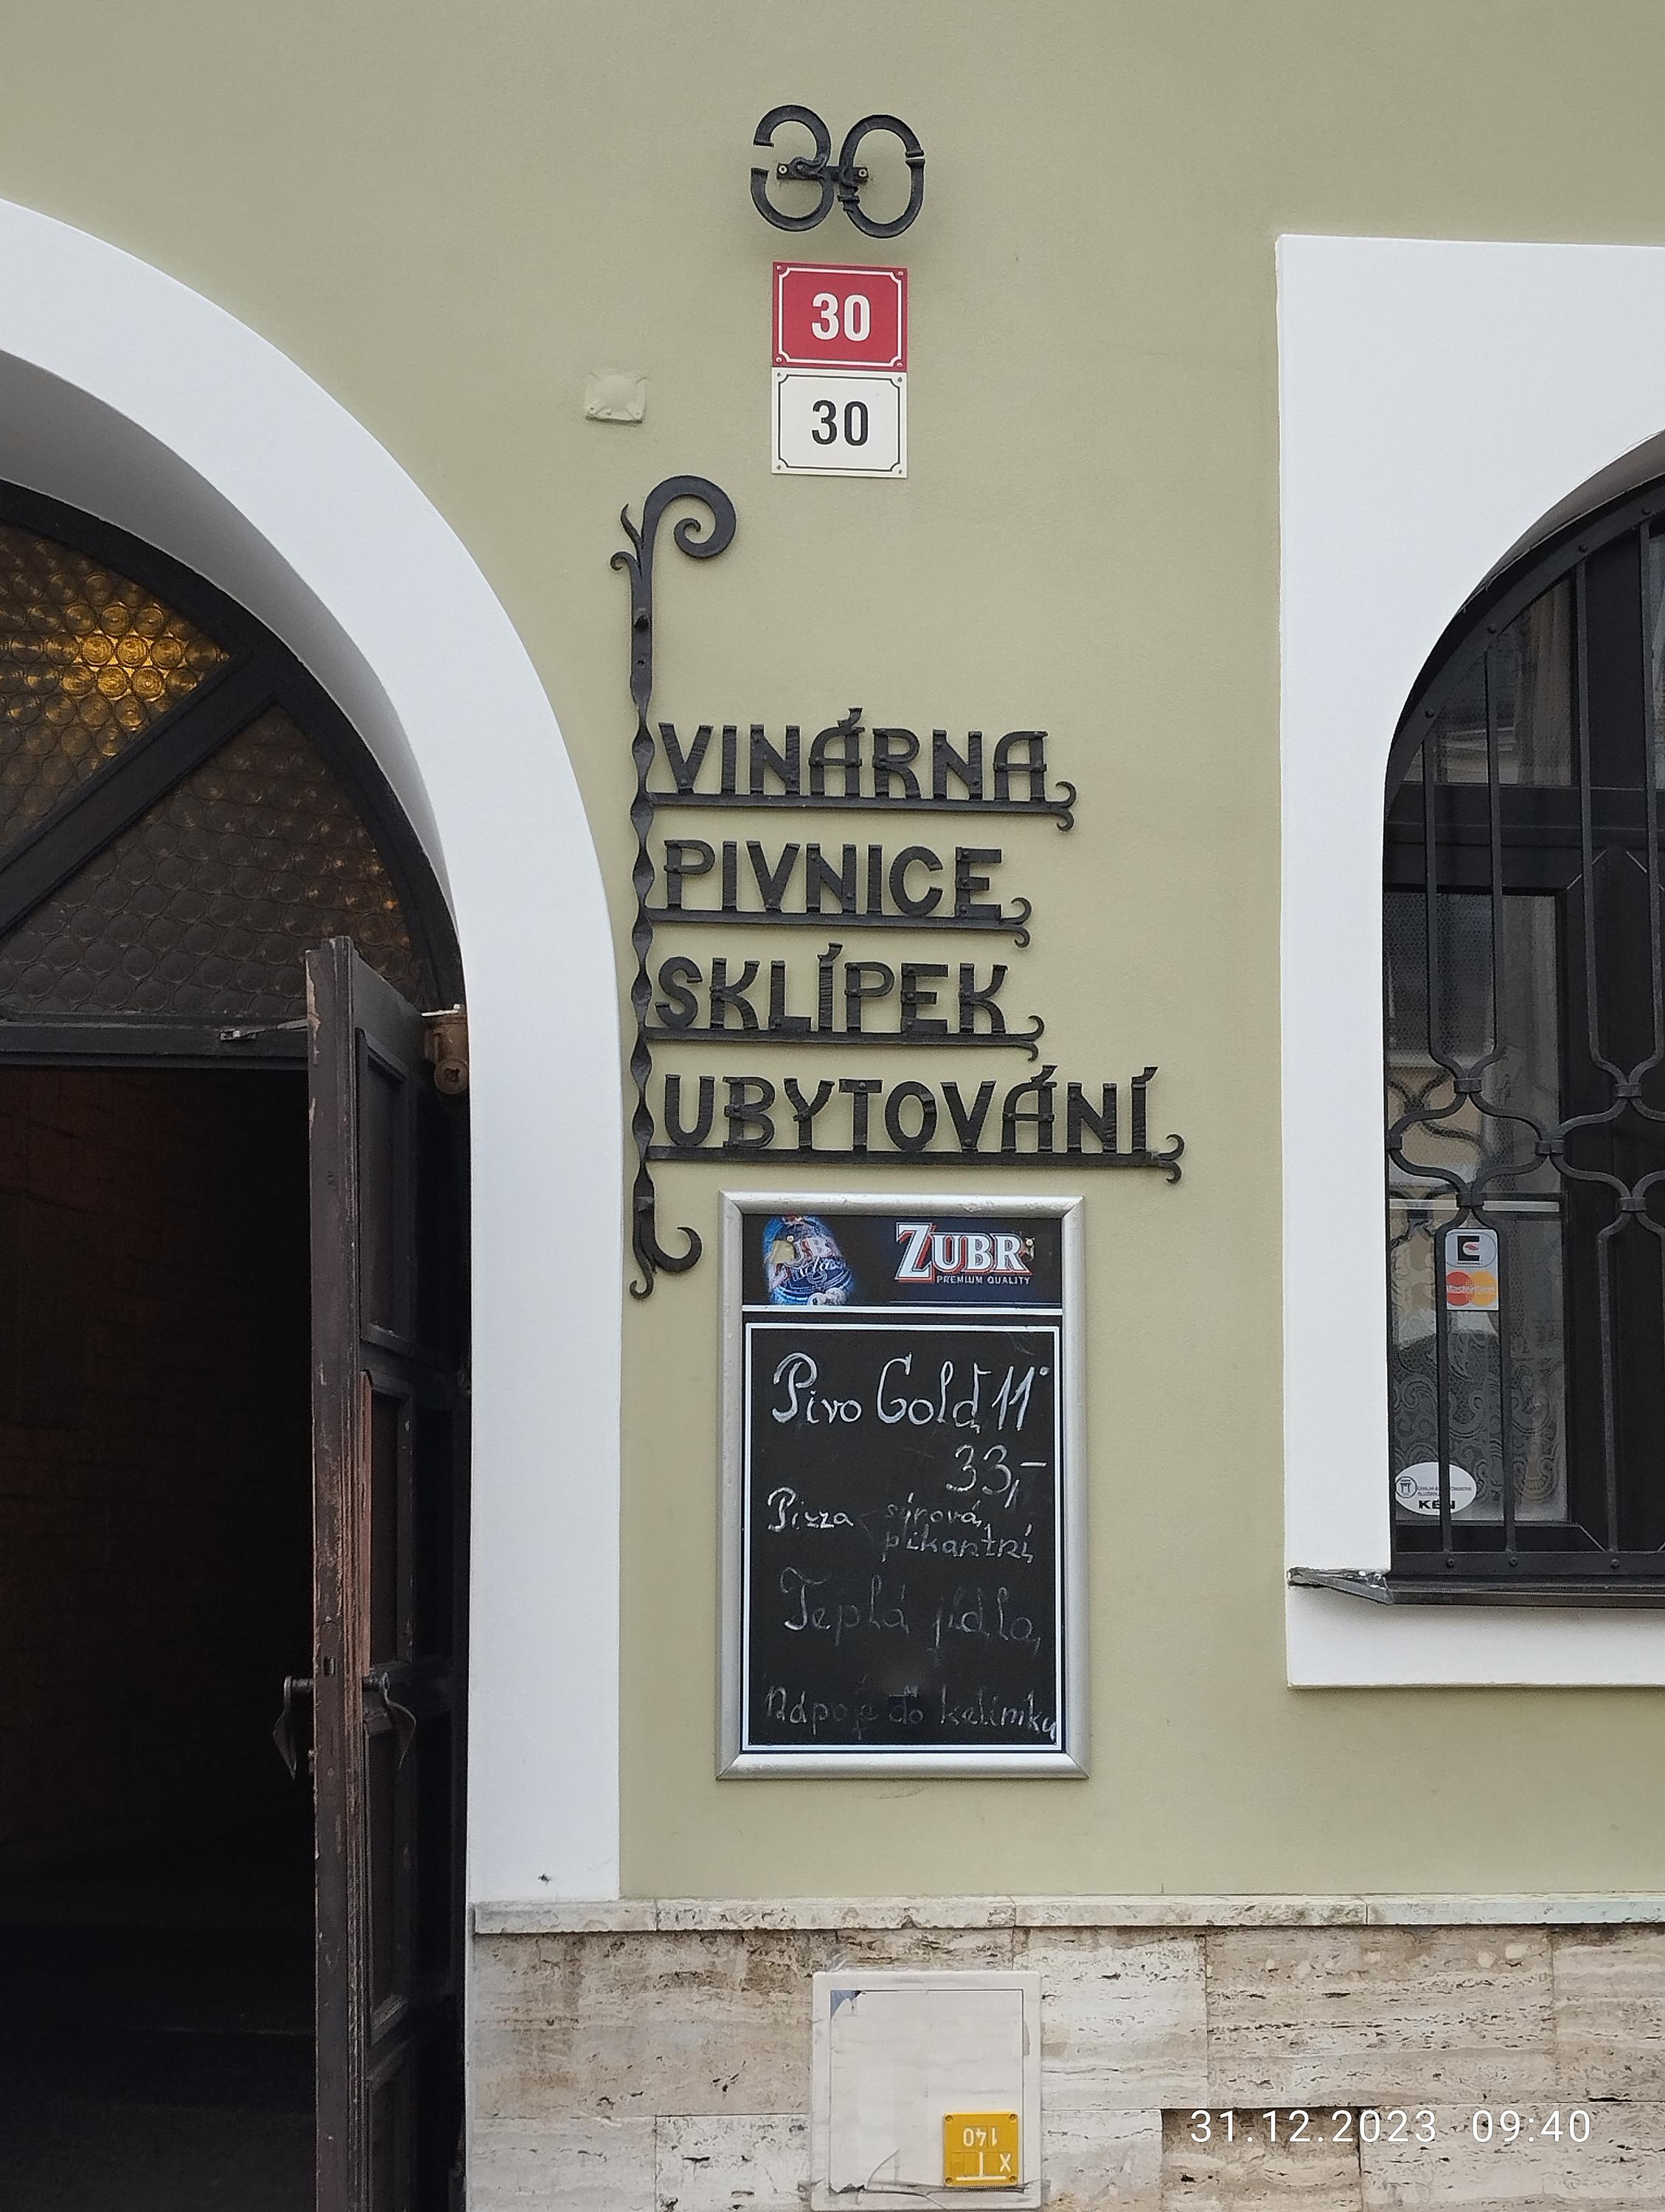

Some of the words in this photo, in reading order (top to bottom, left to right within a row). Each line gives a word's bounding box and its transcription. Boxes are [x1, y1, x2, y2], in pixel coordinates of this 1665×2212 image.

[751, 105, 925, 239] 30
[811, 293, 872, 342] 30
[811, 400, 869, 447] 30
[658, 708, 1048, 802] VINÁRNA
[664, 839, 1002, 919] PIVNICE
[655, 943, 1009, 1034] SKLÍPEK
[664, 1065, 1158, 1154] UBYTOVÁNÍ
[894, 1222, 1033, 1283] ZUBR
[936, 1275, 984, 1284] PREMIUM
[986, 1275, 1031, 1285] QUALITY
[771, 1352, 863, 1424] Pivo
[767, 1486, 855, 1533] Pizza
[962, 2127, 998, 2147] 140
